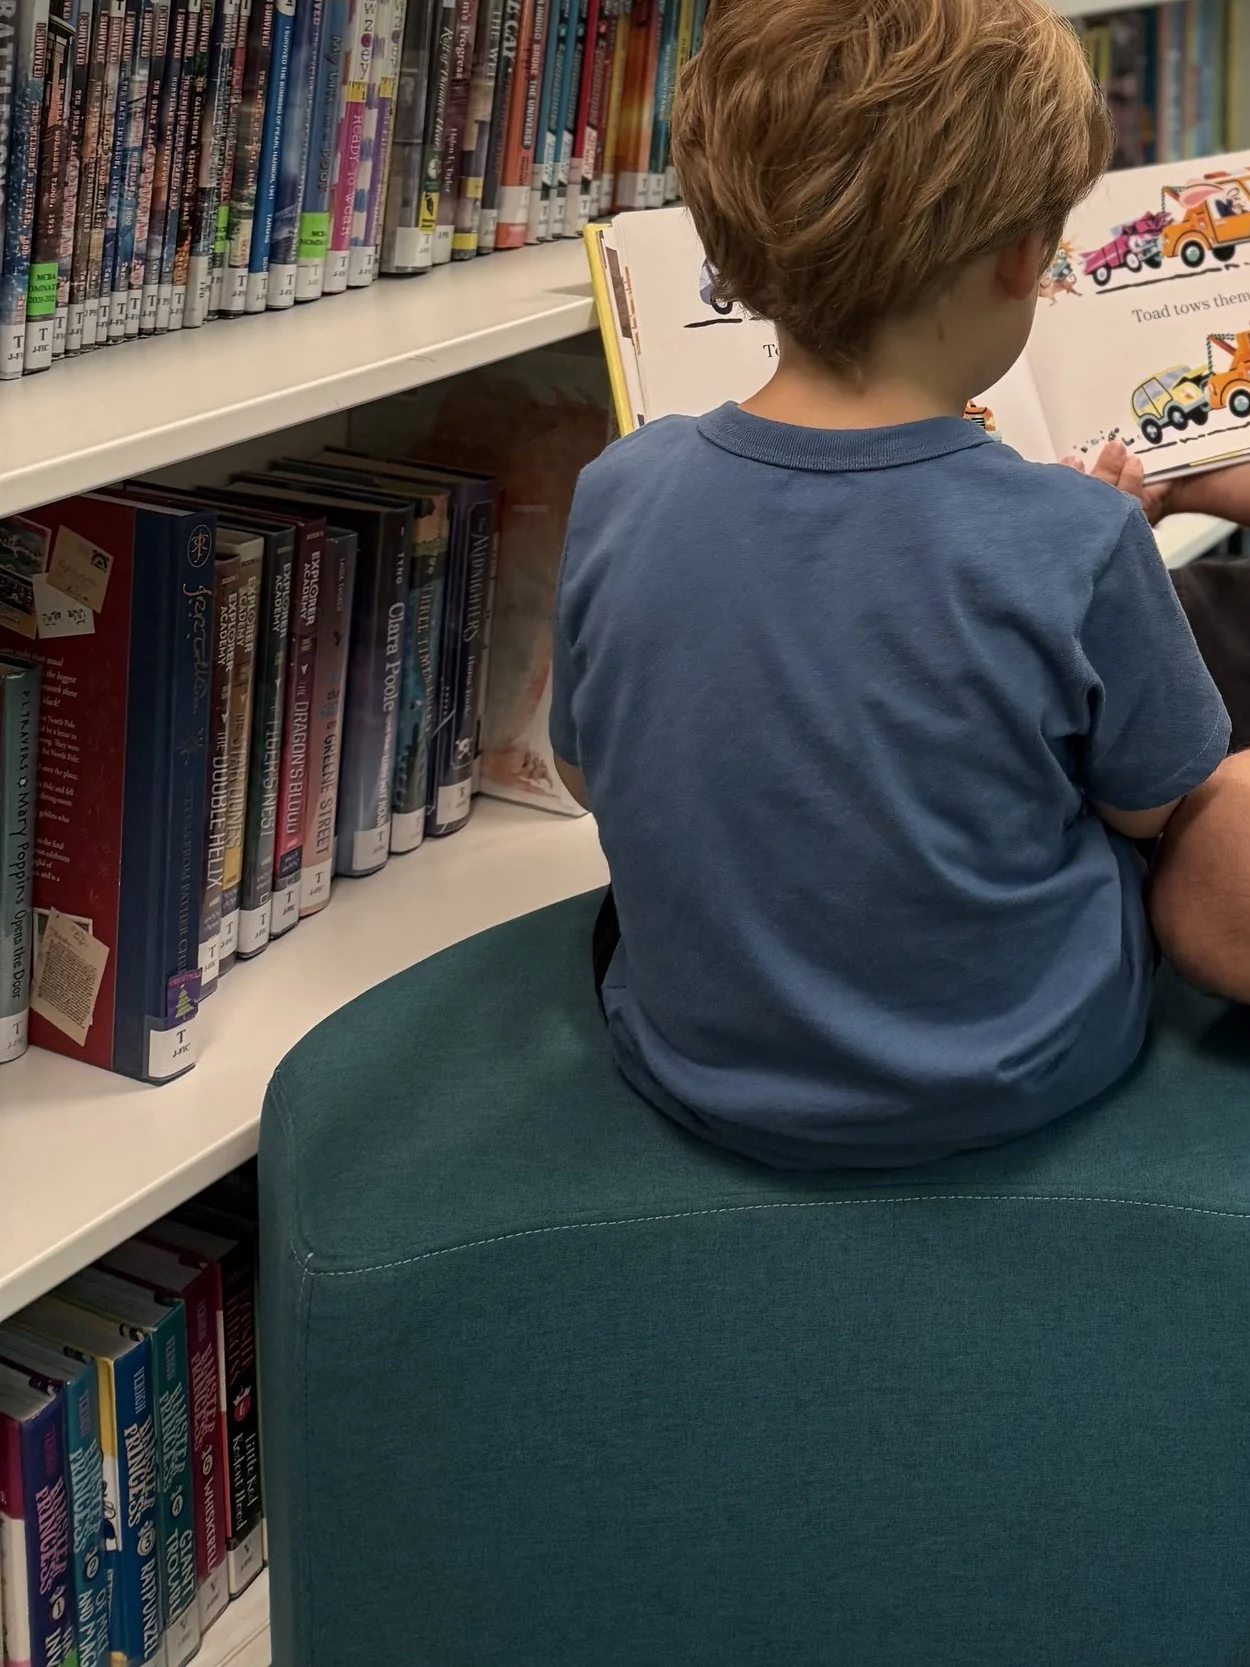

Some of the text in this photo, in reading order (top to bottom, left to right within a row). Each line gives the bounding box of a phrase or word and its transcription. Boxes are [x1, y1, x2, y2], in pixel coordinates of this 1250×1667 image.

[116, 0, 124, 11] T
[261, 3, 273, 47] SURVIVED
[489, 8, 502, 44] THE
[533, 3, 545, 41] INDIGO
[33, 27, 45, 79] SURVIVED
[76, 16, 88, 65] SURVIVED
[96, 14, 108, 63] SURVIVED
[109, 17, 120, 64] SURVIVED
[140, 11, 152, 58] SURVIVED
[155, 11, 167, 57] SURVIVED
[172, 12, 185, 59] SURVIVED
[185, 12, 197, 57] SURVIVED
[199, 7, 211, 53] SURVIVED
[281, 27, 290, 65] SURVIVED
[327, 34, 341, 63] My
[441, 25, 453, 54] Roll
[454, 23, 469, 80] Progress
[502, 18, 518, 61] CAY
[529, 42, 541, 76] BROKE
[113, 15, 134, 170] SURVIVED INVASION,
[276, 80, 285, 114] BOMBING
[527, 78, 537, 98] THE
[190, 95, 201, 145] CALIFORNIA
[272, 125, 280, 151] PEARL
[447, 126, 458, 156] Helen
[522, 97, 536, 146] UNIVERSE
[270, 150, 278, 183] HARBOR,
[48, 176, 57, 207] FLOOD,
[267, 181, 275, 201] 1941
[238, 275, 247, 287] T
[286, 274, 295, 286] T
[340, 256, 347, 268] T
[366, 254, 374, 266] T
[131, 298, 140, 310] T
[148, 295, 156, 307] T
[175, 293, 184, 305] T
[261, 278, 268, 290] T
[56, 316, 65, 329] T
[76, 312, 84, 325] T
[100, 306, 109, 317] T
[117, 303, 126, 315] T
[1130, 303, 1171, 323] Toad
[1172, 297, 1211, 316] tows
[13, 336, 24, 349] T
[32, 345, 49, 353] J-FIC
[39, 328, 48, 341] T
[304, 550, 320, 627] EXPLORER
[395, 551, 404, 585] TYNG
[462, 535, 489, 641] MIDNIGHTERS
[241, 575, 256, 653] EXPLORER
[271, 575, 285, 633] ACADEMY
[276, 562, 291, 639] EXPLORER
[299, 562, 311, 621] ACADEMY
[417, 584, 432, 634] THREE
[217, 604, 229, 665] ACADEMY
[222, 593, 237, 672] EXPLORER
[235, 587, 249, 647] ACADEMY
[385, 601, 404, 656] Clara
[382, 659, 400, 712] Poole
[259, 722, 279, 837] TIGER'S NEST
[286, 700, 308, 834] DRAGON'S BLOOD
[206, 730, 228, 890] THE DOUBLE HELIX
[224, 784, 243, 849] DUNES
[315, 732, 336, 856] GREENE STREET
[8, 791, 29, 999] Mary Poppins Opens the Door
[286, 890, 294, 904] T
[315, 872, 324, 884] T
[178, 886, 189, 936] FATHER
[227, 921, 234, 935] T
[260, 913, 267, 925] T
[209, 944, 217, 959] T
[13, 1021, 23, 1035] T
[172, 1044, 191, 1058] J-FIC
[176, 1029, 186, 1044] T
[132, 1365, 147, 1415] VERNON
[189, 1350, 212, 1452] PRINCESS
[193, 1341, 217, 1434] HAMSTER
[157, 1389, 182, 1493] PRINCESS
[162, 1381, 188, 1478] HAMSTER
[123, 1422, 147, 1528] PRINCESS
[129, 1414, 156, 1511] HAMSTER
[231, 1431, 247, 1530] Rodent Hood
[244, 1432, 257, 1506] Little Red
[68, 1446, 94, 1553] PRINCESS
[78, 1439, 108, 1535] HAMSTER
[35, 1485, 57, 1595] PRINCESS
[46, 1475, 67, 1574] HAMSTER
[178, 1528, 195, 1597] GIANT
[77, 1590, 93, 1622] AND
[139, 1557, 159, 1660] RATPUNZEL
